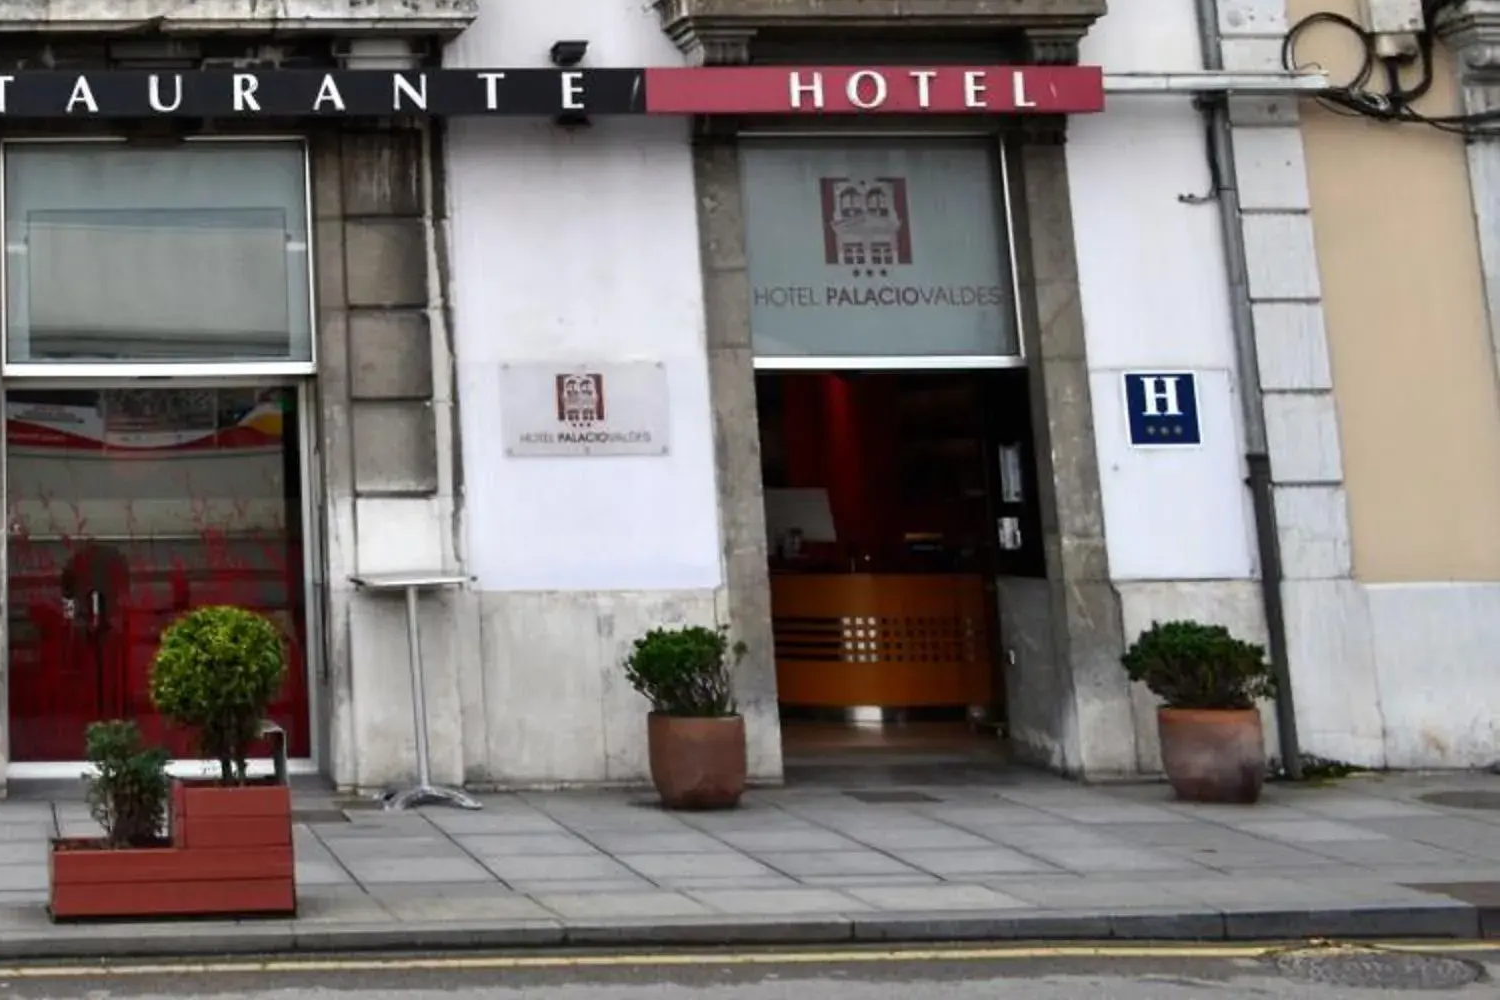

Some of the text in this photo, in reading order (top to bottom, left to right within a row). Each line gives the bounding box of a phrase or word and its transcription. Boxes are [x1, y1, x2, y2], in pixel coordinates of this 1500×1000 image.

[789, 70, 1037, 108] HOTEL
[754, 285, 819, 307] HOTEL
[1140, 376, 1184, 416] H
